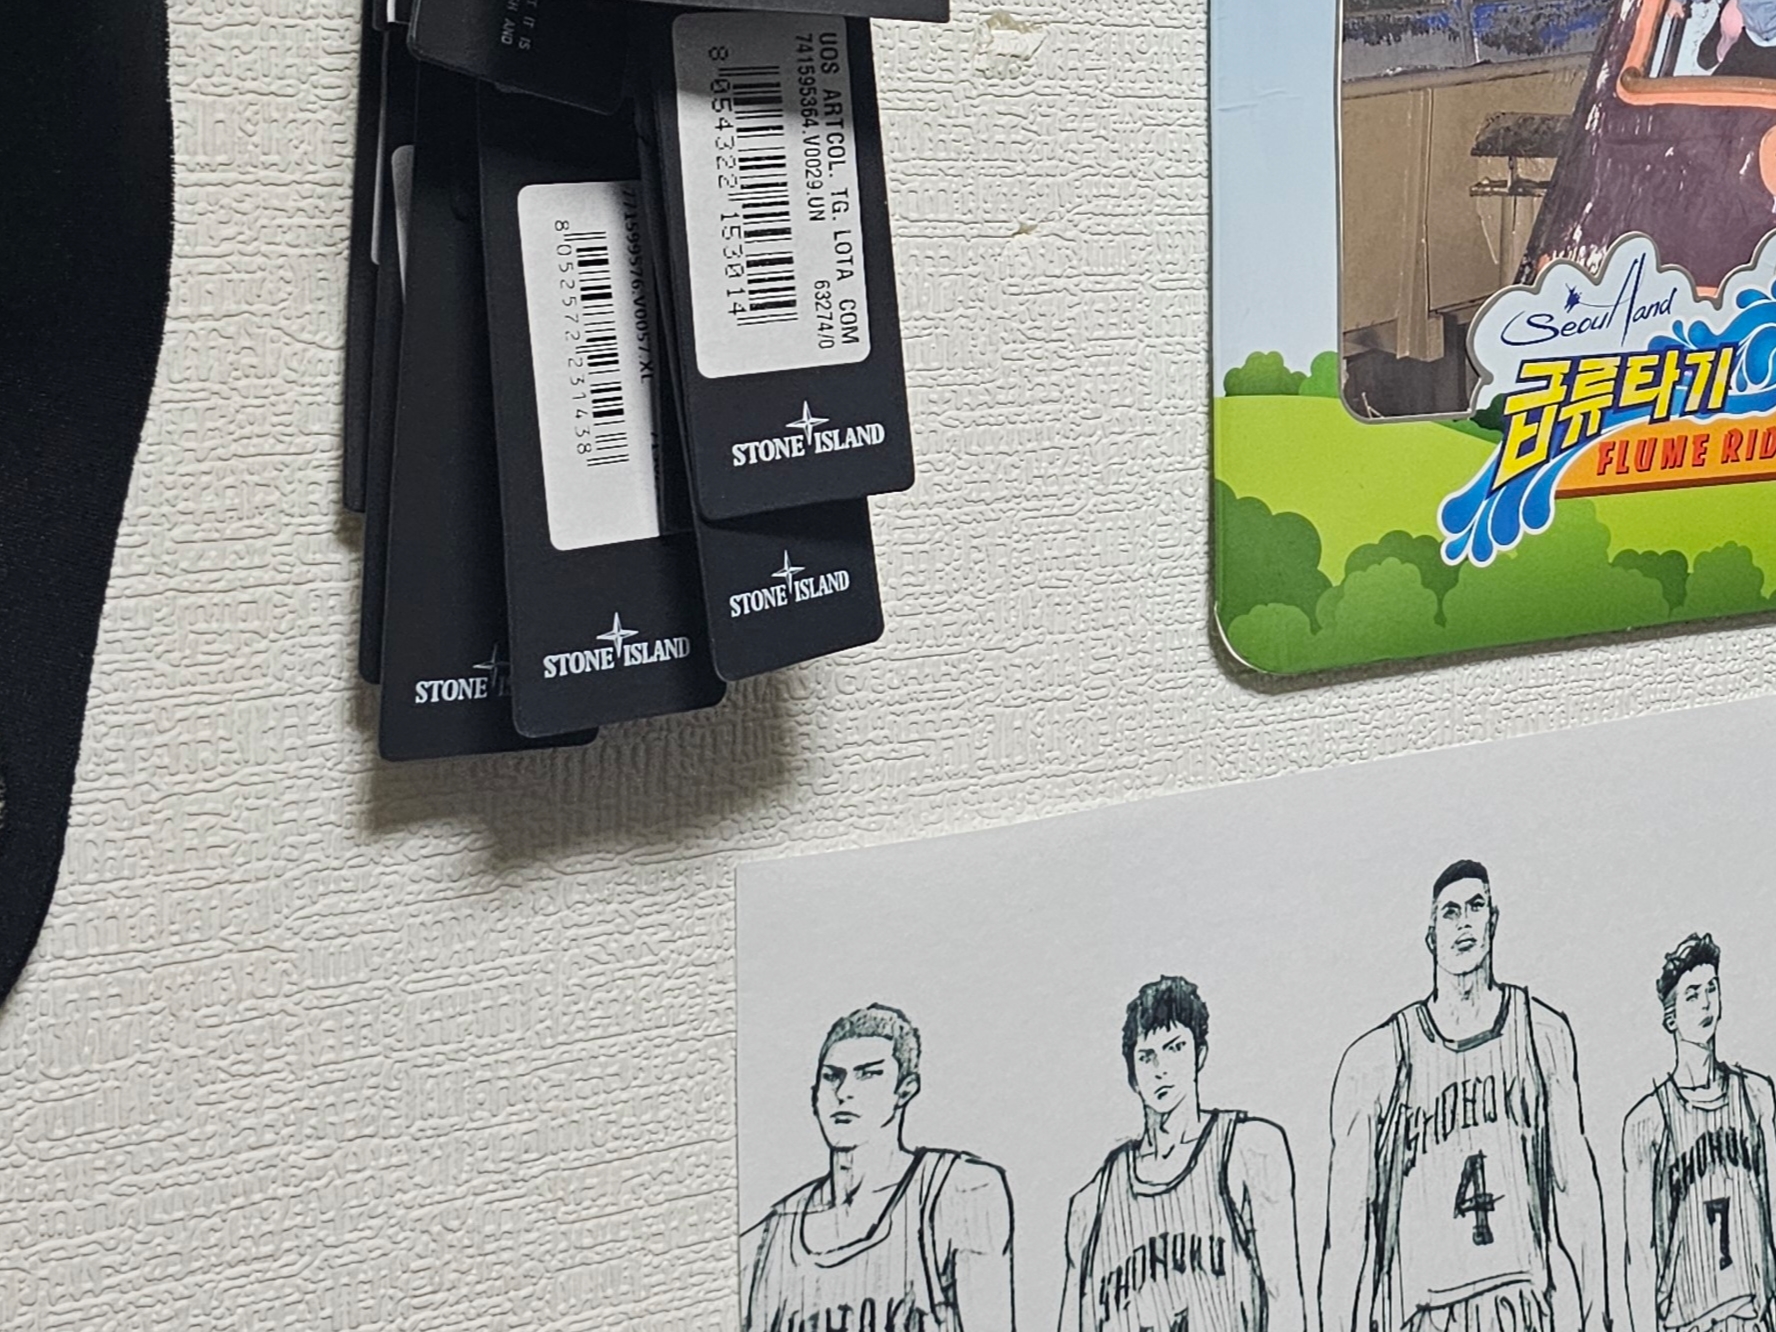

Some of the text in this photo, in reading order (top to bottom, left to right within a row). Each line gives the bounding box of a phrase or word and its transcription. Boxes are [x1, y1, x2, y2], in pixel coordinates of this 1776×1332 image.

[819, 32, 841, 75] UOS
[831, 187, 850, 221] TG.
[834, 230, 854, 281] LOTA
[814, 280, 835, 349] 63274/0
[839, 299, 860, 344] COM
[1492, 347, 1732, 492] 급류타기
[731, 422, 886, 468] STONE ISLAND
[1597, 433, 1710, 476] FLUME
[729, 570, 850, 619] STONE ISLAND
[543, 637, 691, 680] STONE ISLAND
[415, 676, 489, 704] STONE
[1453, 1149, 1506, 1246] 4
[1703, 1196, 1733, 1271] 7
